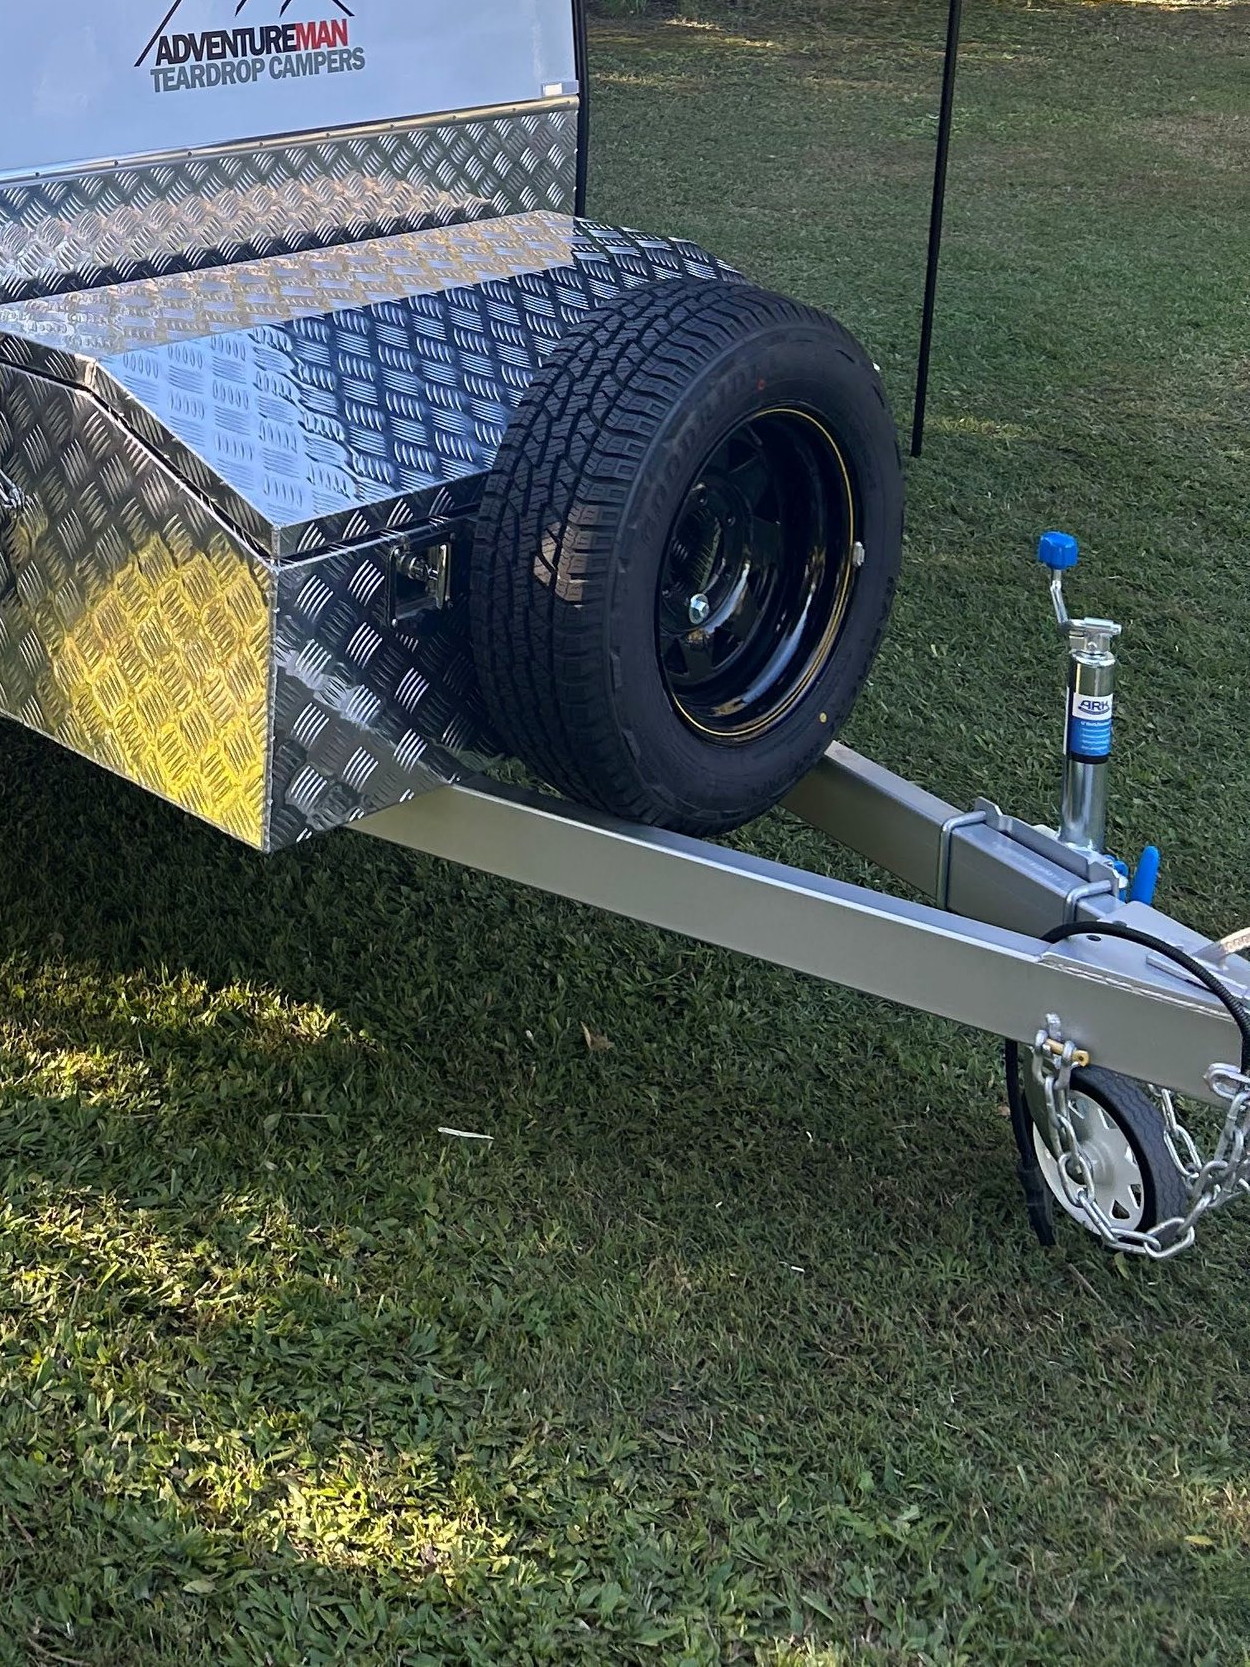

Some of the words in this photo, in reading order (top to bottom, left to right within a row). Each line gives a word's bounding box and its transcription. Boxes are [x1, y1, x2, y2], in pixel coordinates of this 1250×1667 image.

[155, 18, 348, 66] ADVENTUREMAN
[150, 57, 266, 93] TEARDROP
[268, 46, 366, 81] CAMPERS
[1080, 699, 1110, 712] ARK
